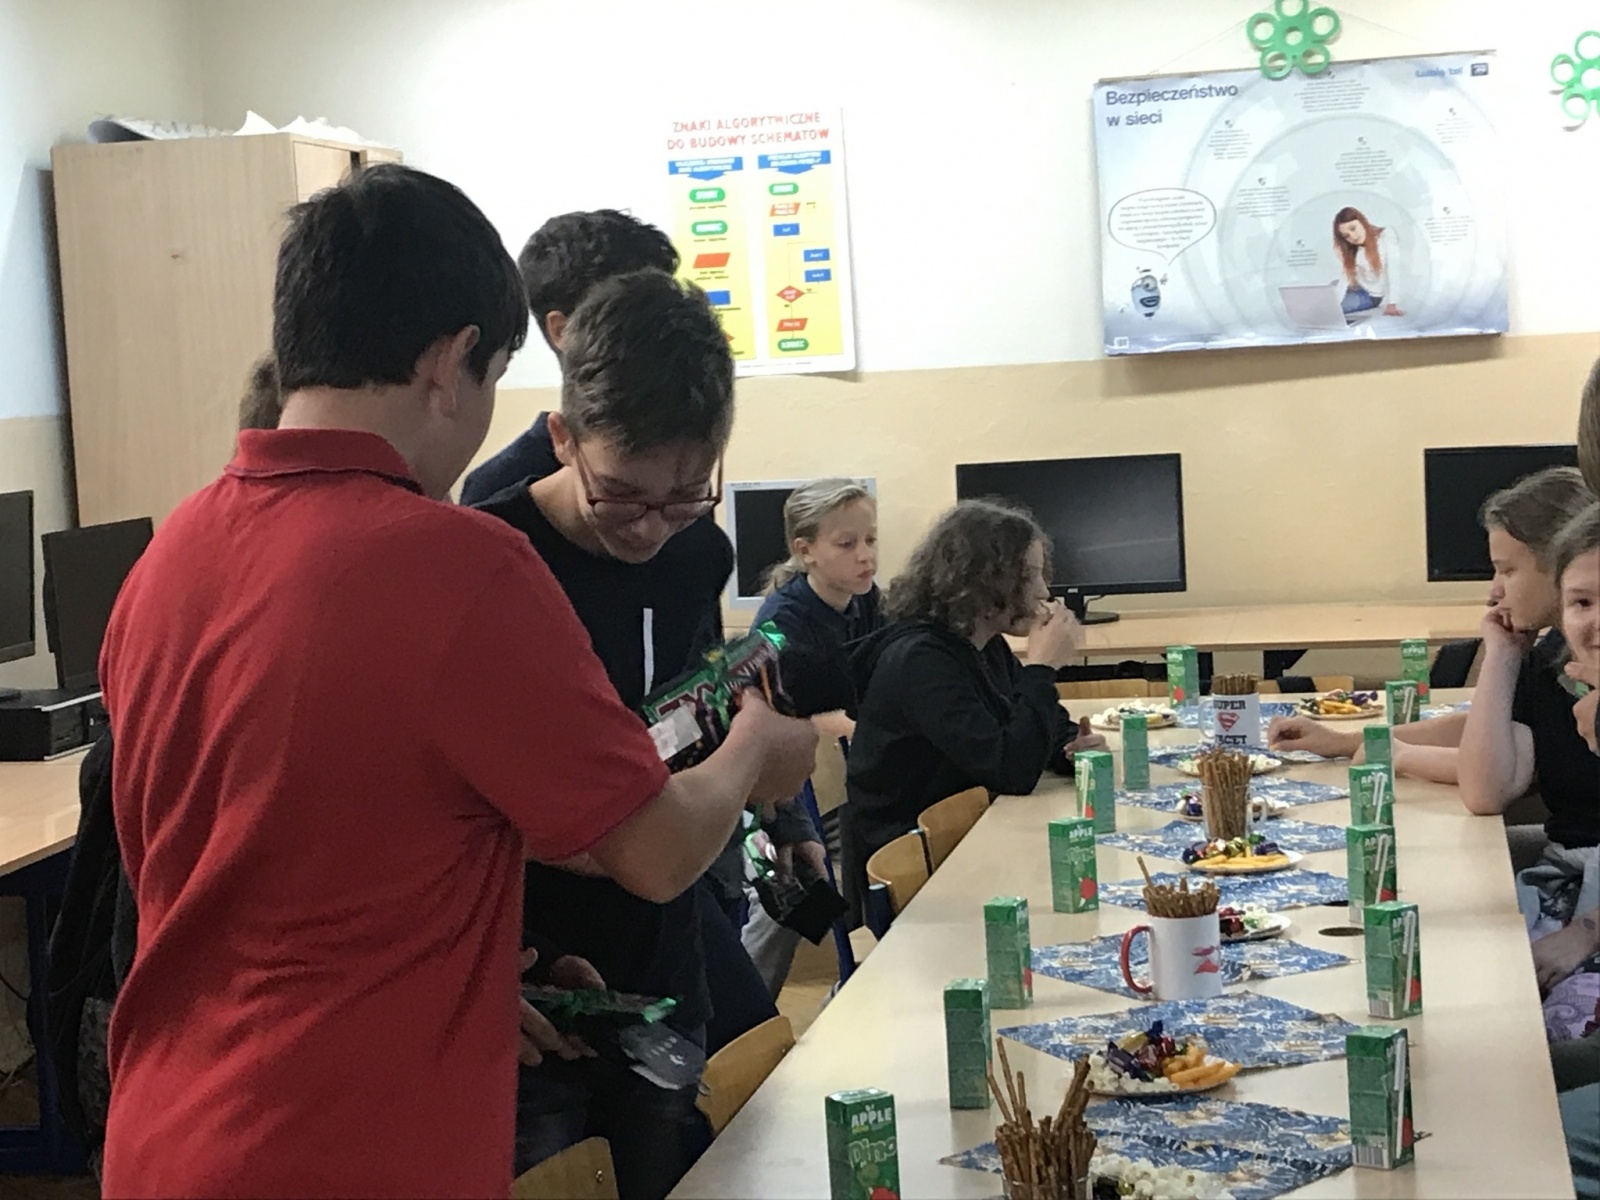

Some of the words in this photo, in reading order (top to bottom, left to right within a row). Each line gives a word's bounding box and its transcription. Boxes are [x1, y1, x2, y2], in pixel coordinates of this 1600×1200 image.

[1105, 84, 1239, 106] Bezpieczeństwo
[672, 119, 711, 133] ZNAKI
[716, 112, 821, 130] ALGORYTMICZNE
[1106, 115, 1121, 127] w
[1125, 109, 1163, 126] sieci
[667, 139, 685, 150] DO
[690, 135, 746, 149] BUDOWY
[851, 1106, 892, 1128] APPLE
